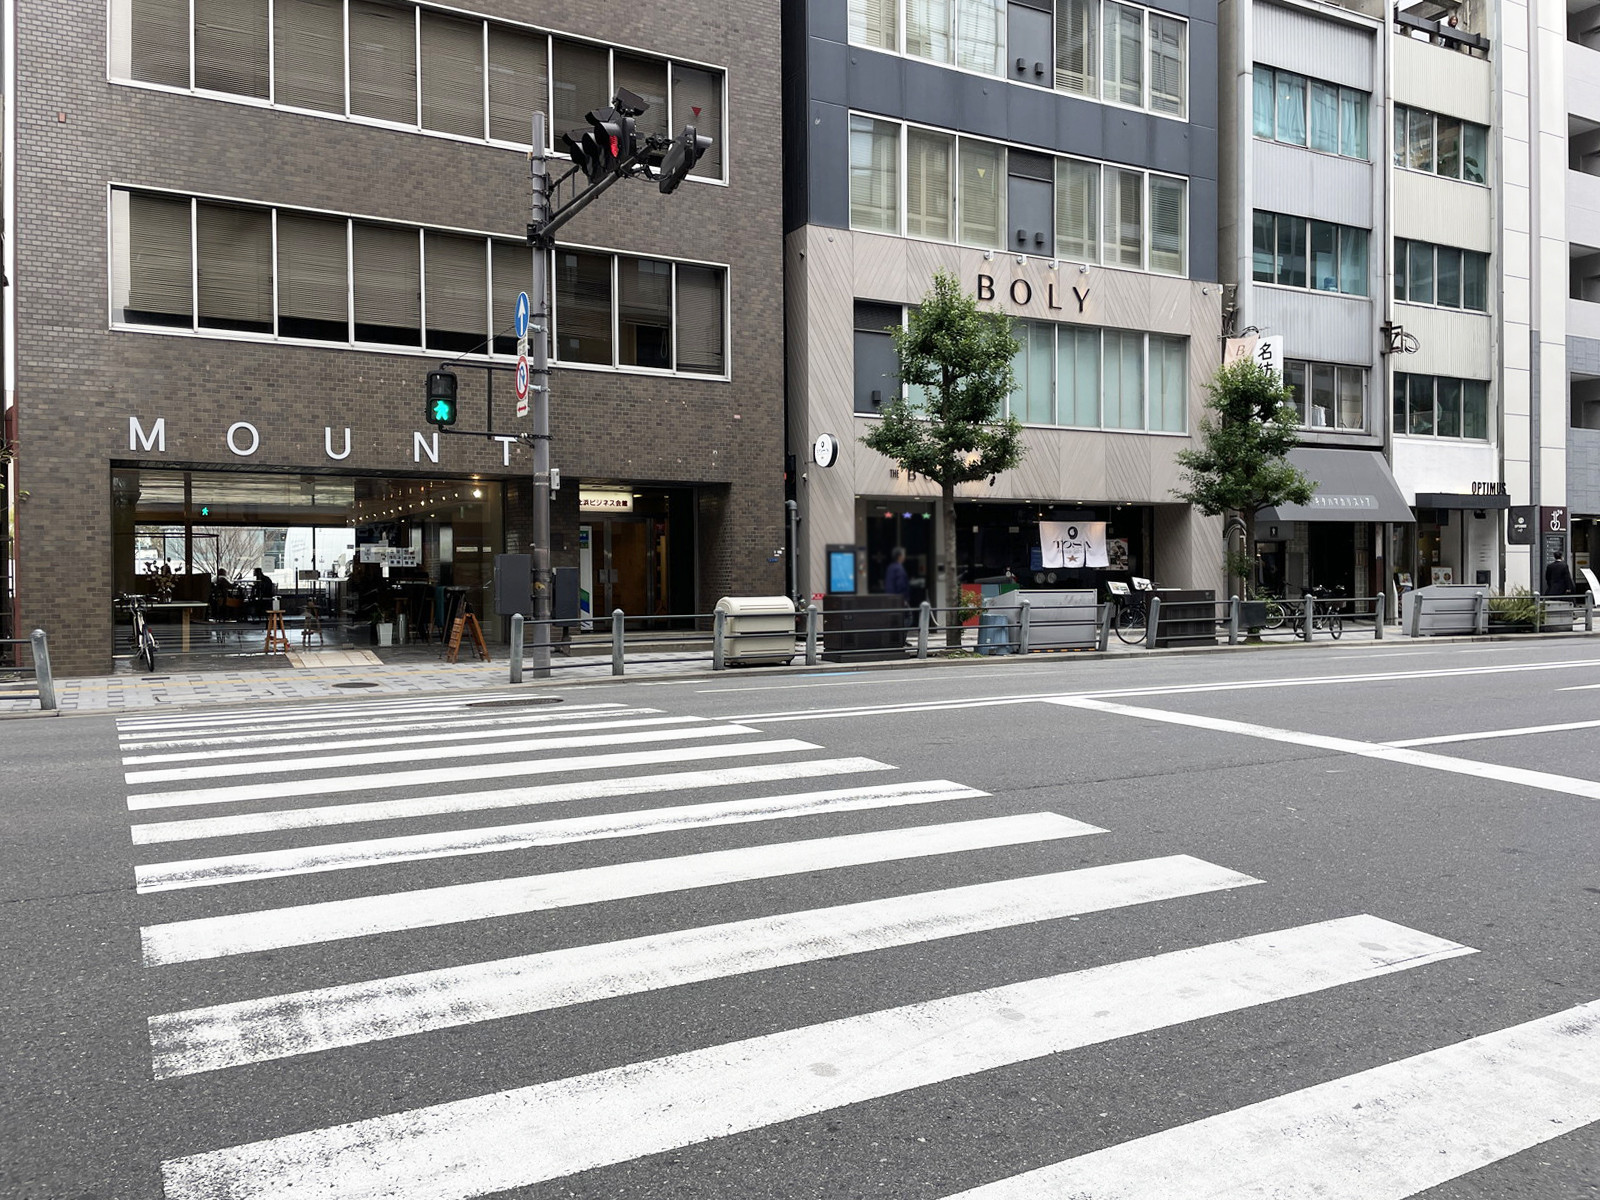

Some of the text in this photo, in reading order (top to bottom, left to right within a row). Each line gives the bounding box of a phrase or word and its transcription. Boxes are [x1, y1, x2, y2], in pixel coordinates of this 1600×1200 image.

[978, 275, 1091, 313] BOLY
[129, 416, 518, 467] MOUNT
[889, 470, 899, 479] THE
[1472, 482, 1506, 495] OPTIMUS
